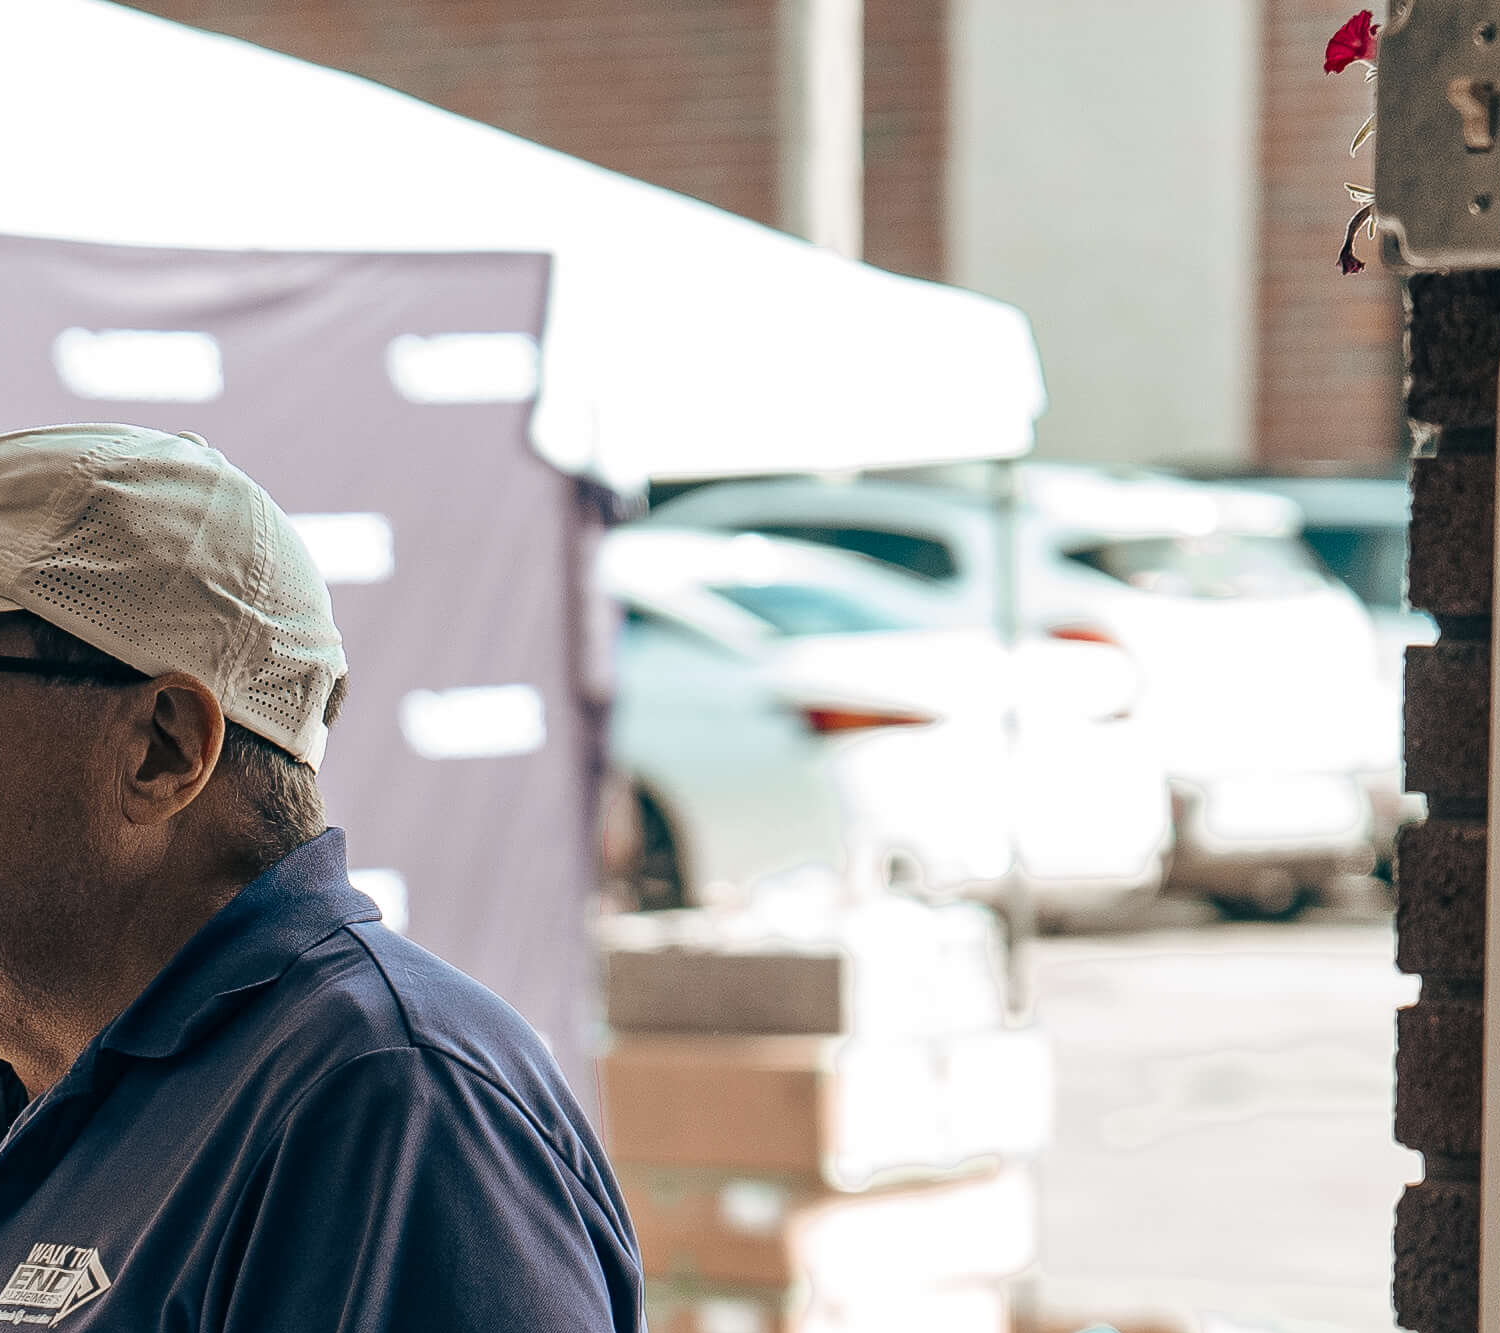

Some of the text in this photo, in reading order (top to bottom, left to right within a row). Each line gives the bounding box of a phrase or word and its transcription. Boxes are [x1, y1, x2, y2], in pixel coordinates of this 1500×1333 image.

[25, 1242, 94, 1270] WALK TO
[9, 1267, 76, 1293] END
